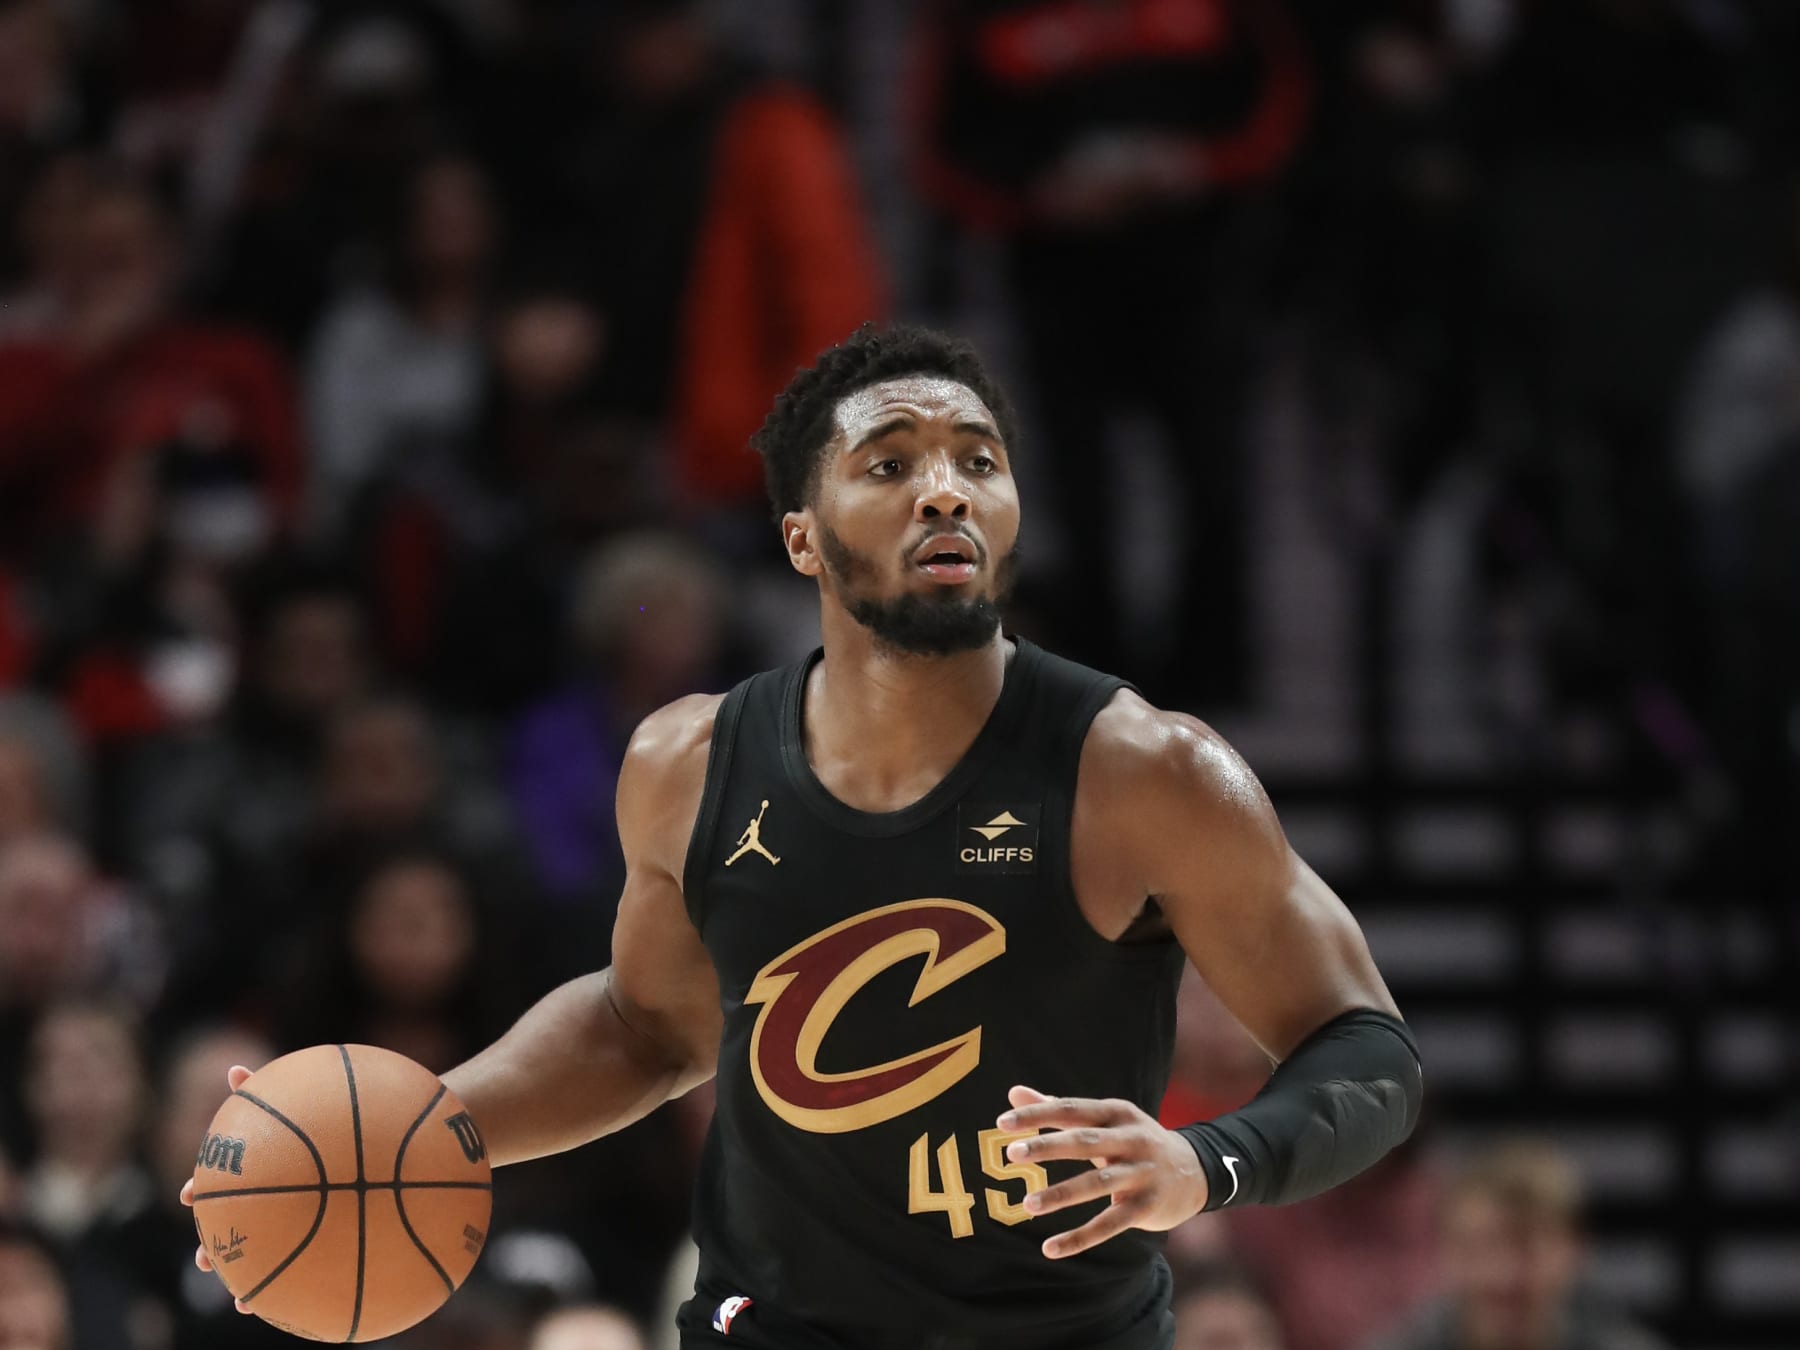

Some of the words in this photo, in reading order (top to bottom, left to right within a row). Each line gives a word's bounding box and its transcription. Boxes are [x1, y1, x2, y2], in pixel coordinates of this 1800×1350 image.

[960, 848, 1033, 862] CLIFFS
[743, 897, 1006, 1134] C
[908, 1127, 1049, 1238] 45
